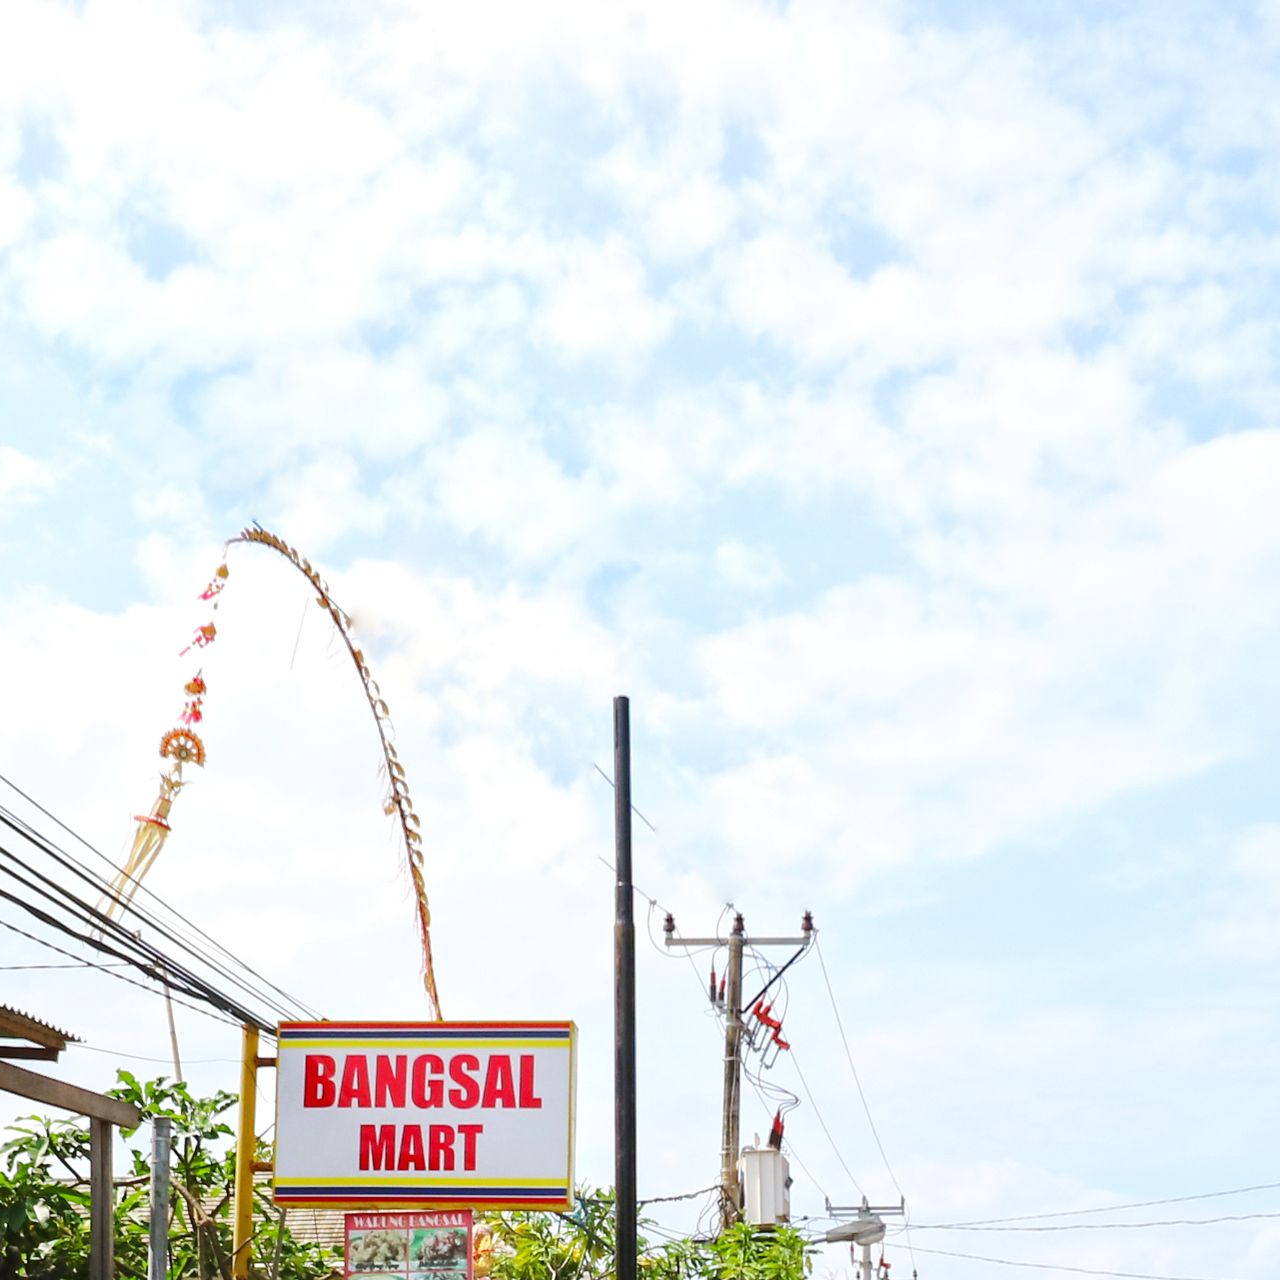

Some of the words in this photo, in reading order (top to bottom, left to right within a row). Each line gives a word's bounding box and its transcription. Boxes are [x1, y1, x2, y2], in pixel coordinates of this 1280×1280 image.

[303, 1054, 542, 1109] BANGSAL
[358, 1123, 484, 1172] MART
[353, 1215, 406, 1228] WARUNG
[409, 1213, 464, 1227] BANGSAL
